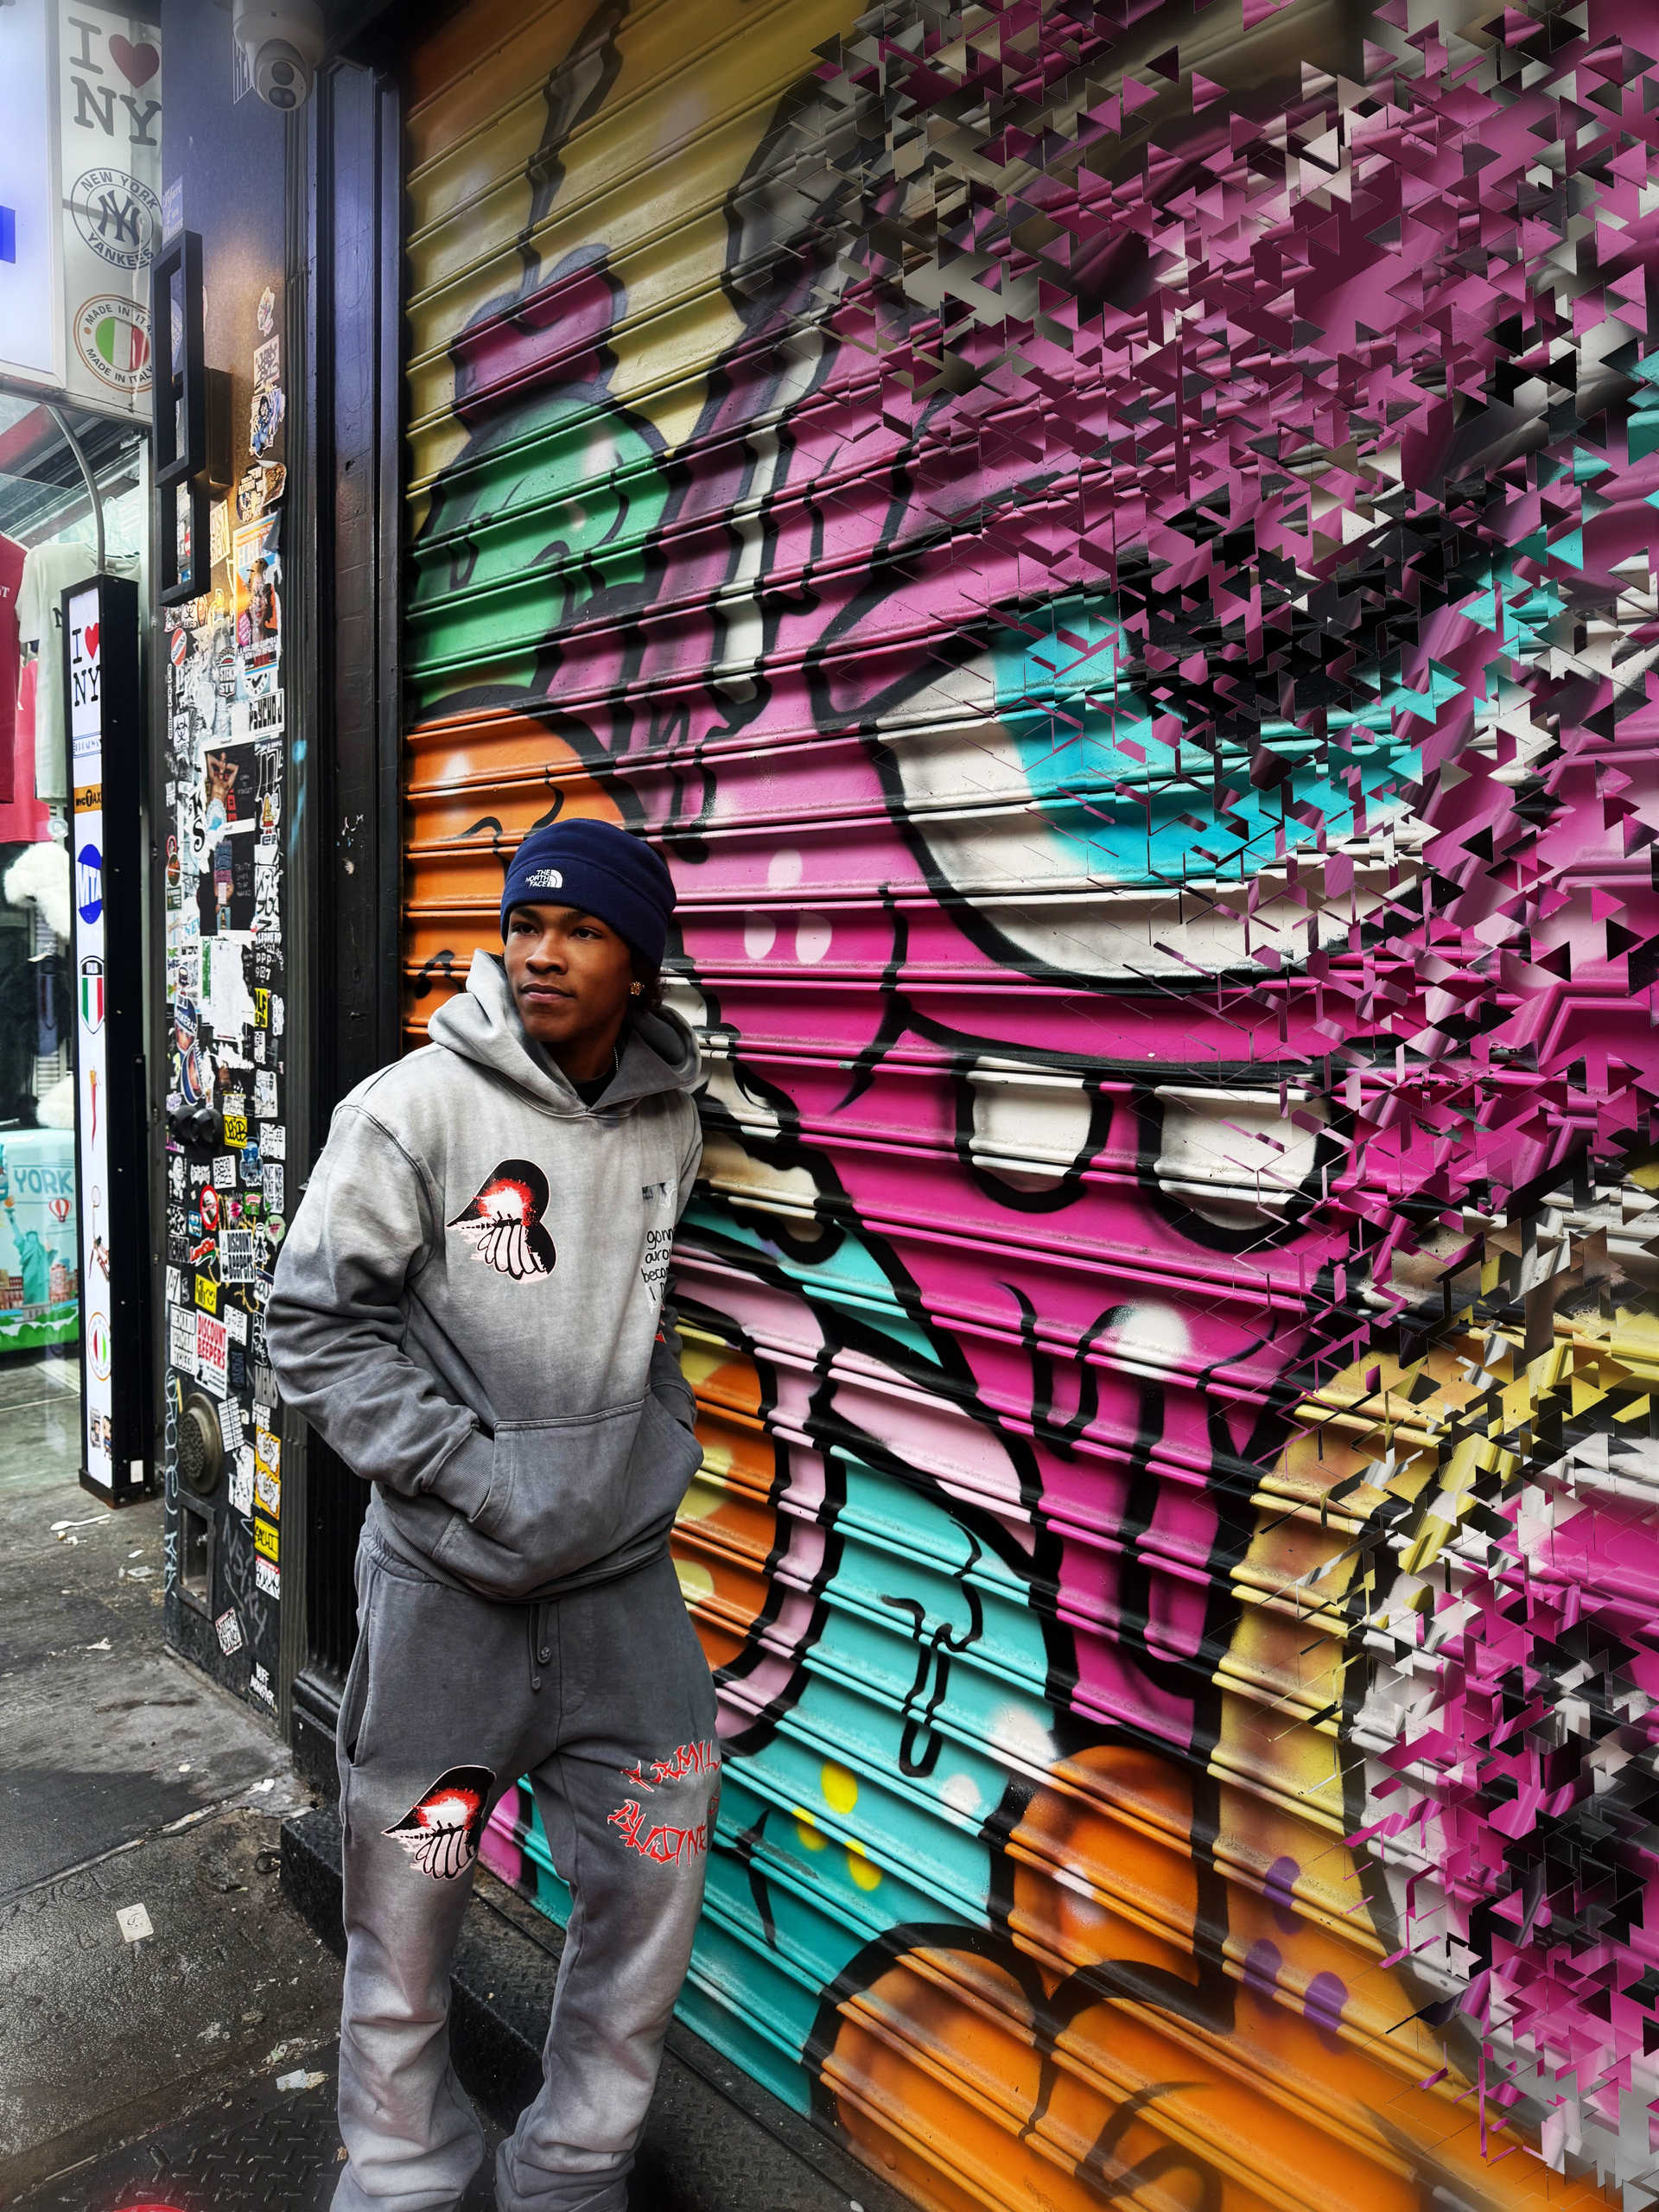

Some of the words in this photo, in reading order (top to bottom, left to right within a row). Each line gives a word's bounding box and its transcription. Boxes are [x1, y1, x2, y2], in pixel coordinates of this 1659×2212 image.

[68, 16, 104, 74] I
[71, 76, 162, 146] NY
[80, 172, 112, 191] NEW
[120, 175, 159, 209] YORK
[88, 232, 154, 266] YANKEES
[85, 304, 113, 326] MADE
[118, 305, 130, 317] IN
[86, 348, 111, 376] MADE
[115, 372, 125, 383] IN
[72, 628, 82, 664] I
[73, 664, 101, 707] NY
[13, 1168, 73, 1195] YORK
[197, 1313, 226, 1350] DISCOUNT
[196, 1336, 226, 1371] BEEPERS
